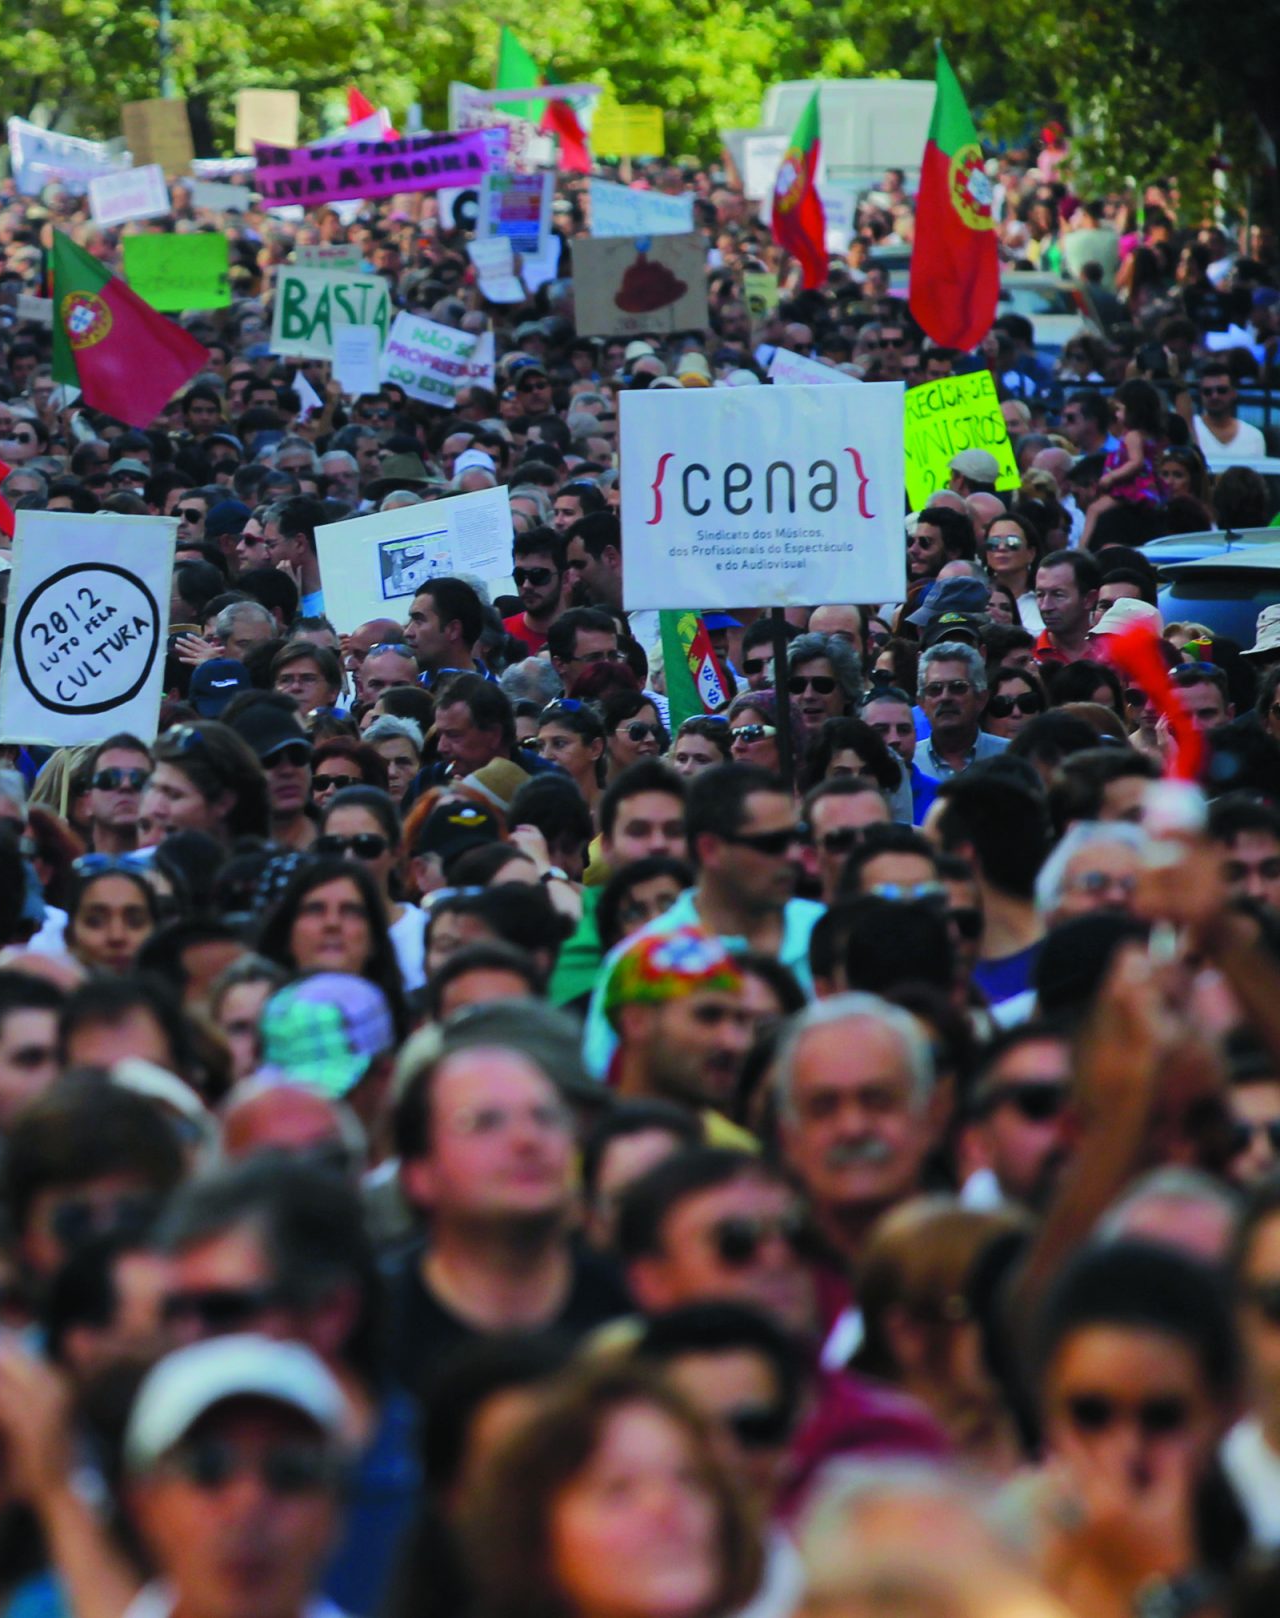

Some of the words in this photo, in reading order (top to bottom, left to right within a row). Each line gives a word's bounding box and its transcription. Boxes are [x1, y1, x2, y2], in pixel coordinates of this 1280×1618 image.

[904, 375, 997, 425] RECISA-SE
[668, 546, 689, 557] dos
[691, 543, 765, 556] Profissionais
[696, 529, 750, 541] Sindicato
[752, 528, 773, 540] dos
[741, 558, 807, 571] Audiovisual
[31, 587, 102, 646] 2012
[39, 636, 80, 673] LUTO
[84, 606, 118, 635] PELA
[56, 616, 150, 702] CULTURA
